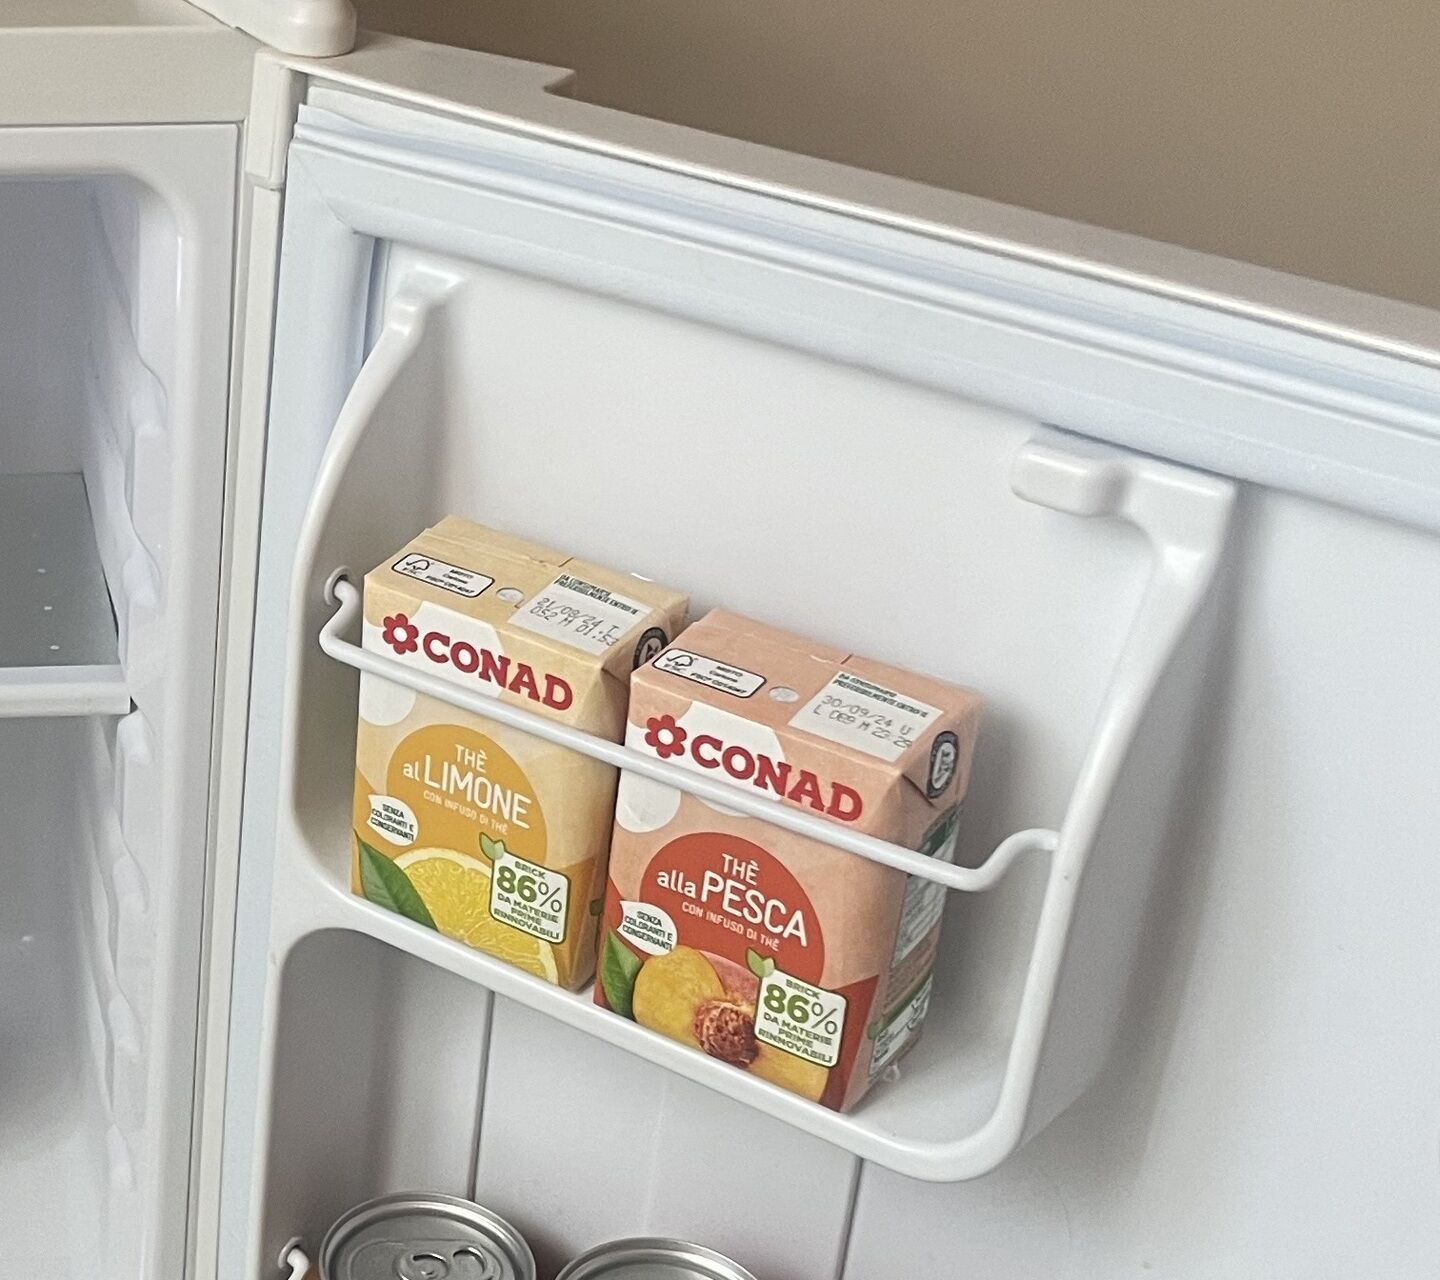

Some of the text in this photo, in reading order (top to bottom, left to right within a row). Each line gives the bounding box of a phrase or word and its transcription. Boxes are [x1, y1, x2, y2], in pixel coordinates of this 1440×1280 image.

[422, 631, 574, 711] CONAD
[821, 694, 894, 728] 30/09/24
[454, 743, 488, 773] THÈ
[402, 754, 533, 830] al LIMONE
[690, 734, 863, 822] CONAD
[423, 789, 443, 805] CON
[444, 796, 477, 822] INFUSO
[478, 812, 490, 826] DI
[514, 860, 546, 880] BRICK
[721, 852, 760, 887] THÈ
[496, 865, 563, 913] 86%
[493, 907, 560, 940] RINNOVABILI
[497, 892, 559, 924] DA MATERIE
[510, 907, 542, 926] PRIME
[656, 869, 808, 949] alla PESCA
[681, 901, 780, 953] CON INFUSO DI THÈ
[785, 978, 820, 1000] BRICK
[763, 983, 838, 1036] 86%
[758, 1027, 833, 1064] RINNOVABILI
[763, 1011, 833, 1047] DA MATERIE
[778, 1027, 814, 1049] PRIME
